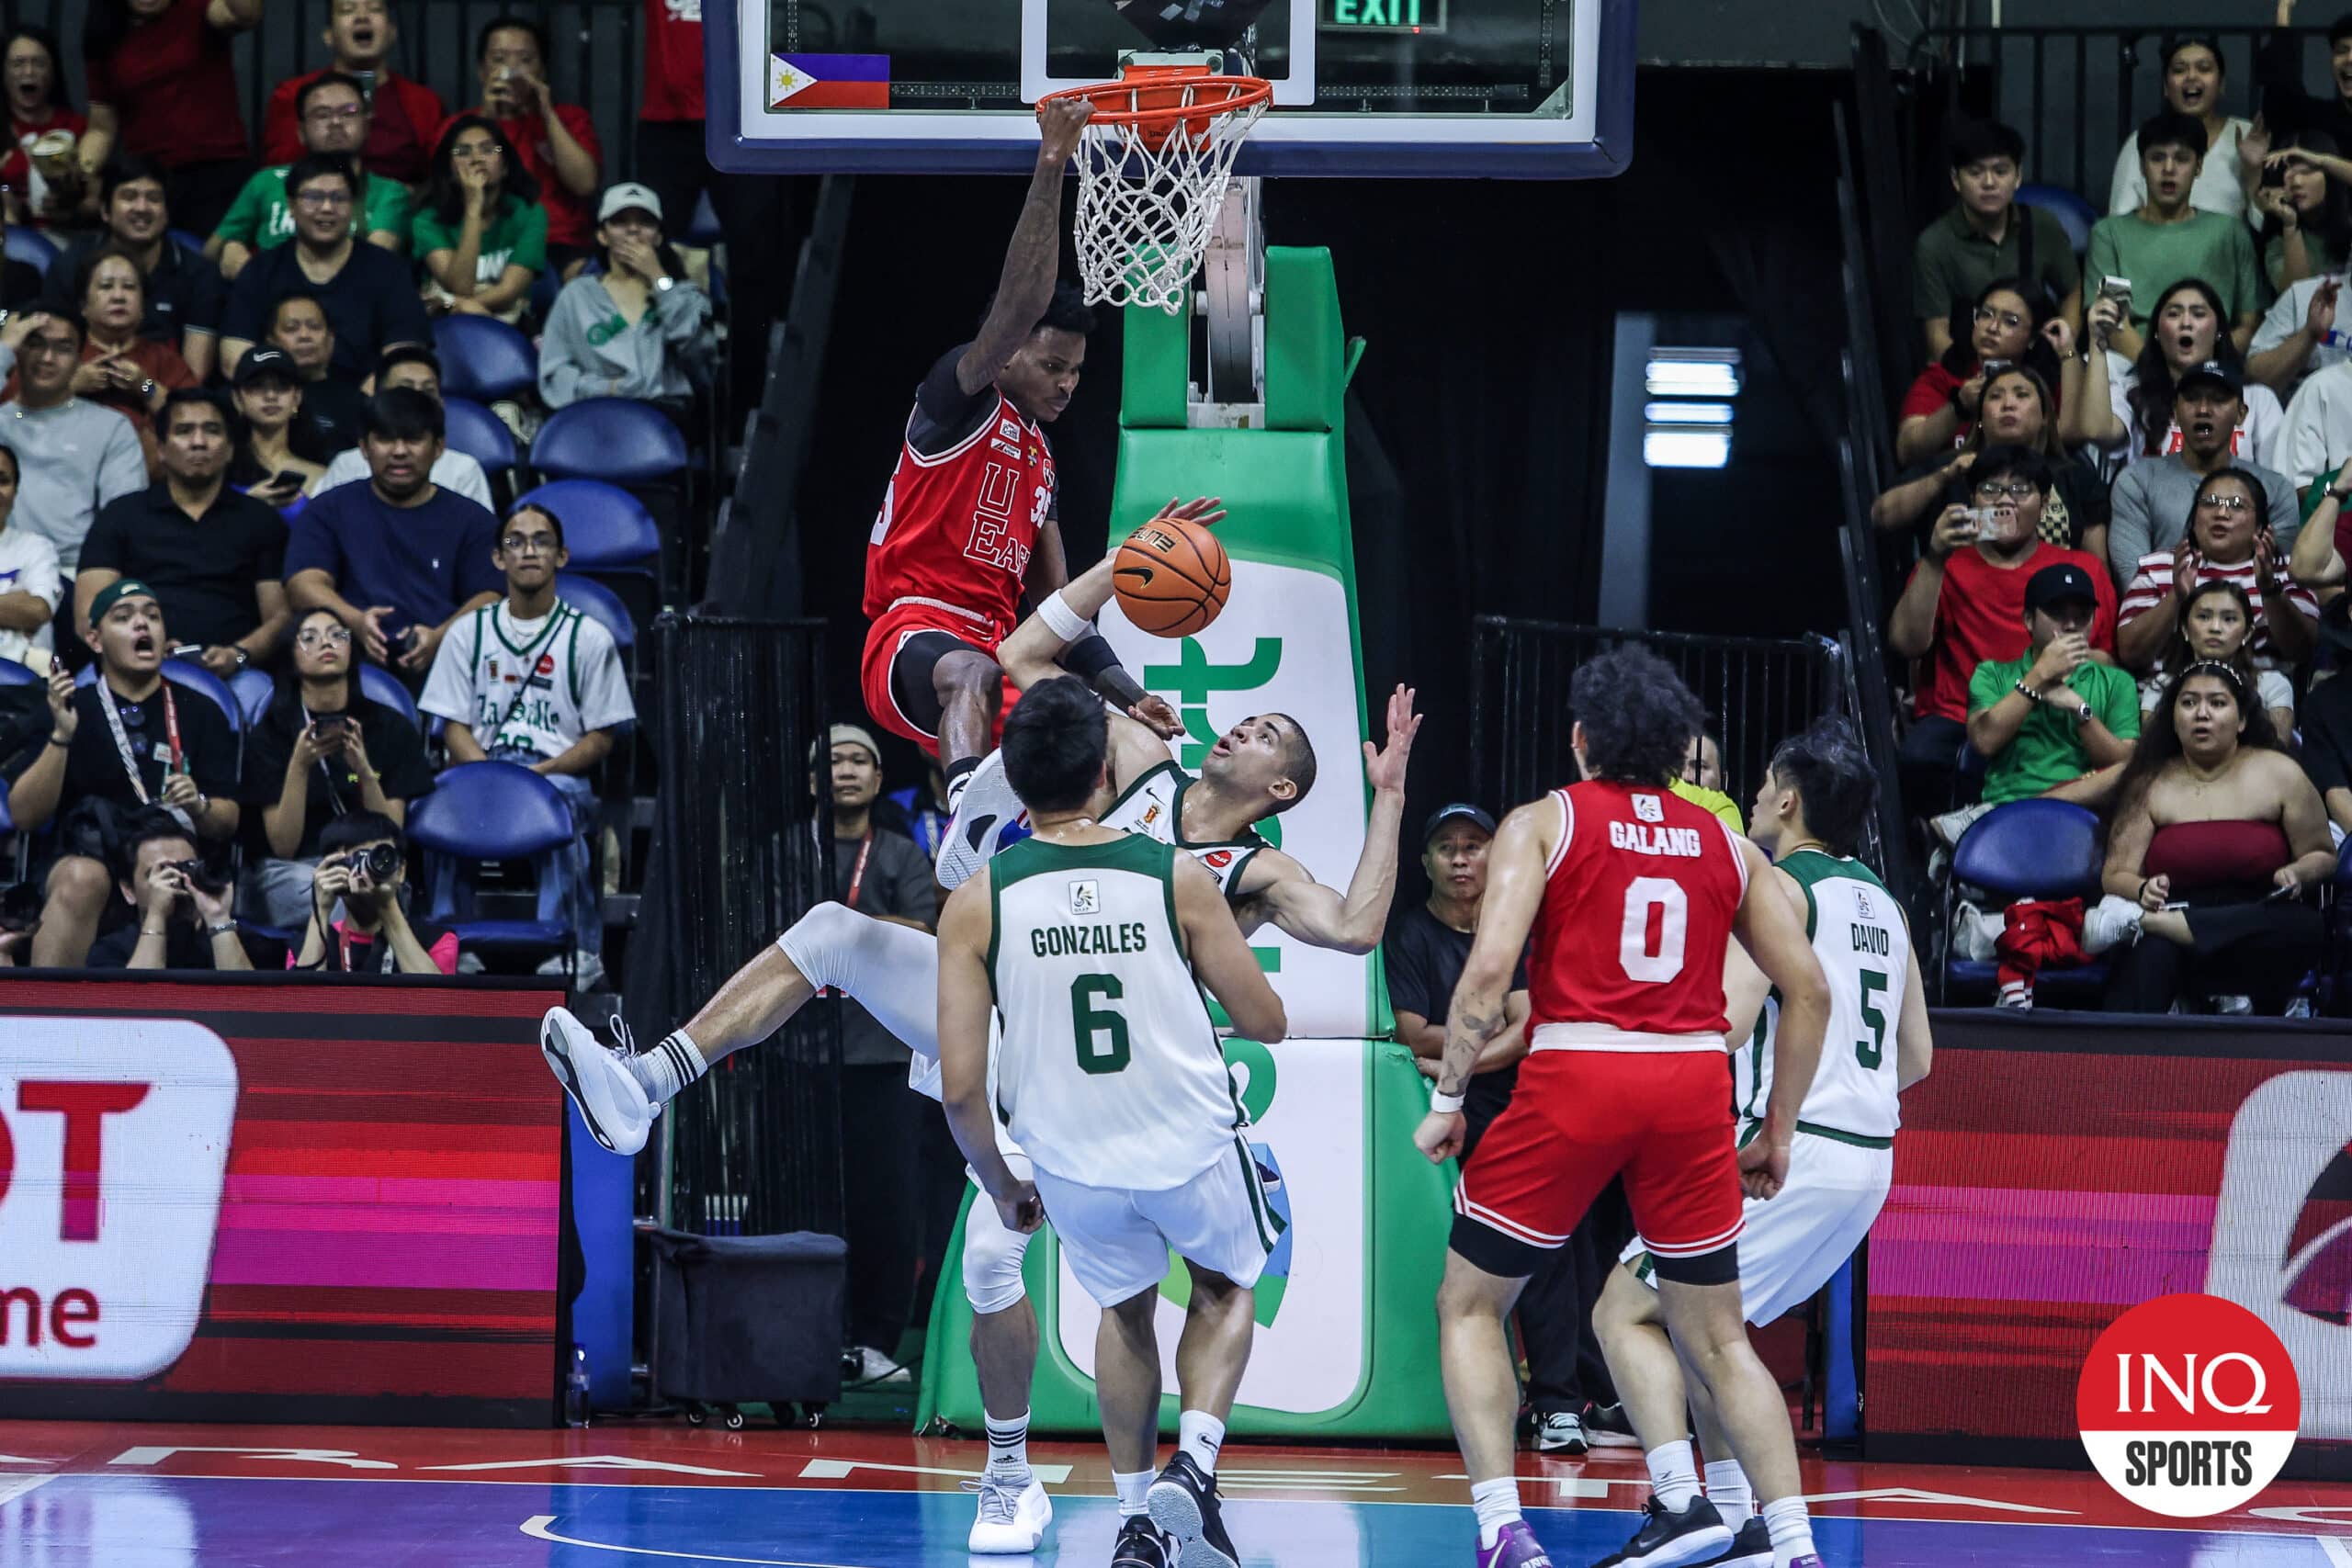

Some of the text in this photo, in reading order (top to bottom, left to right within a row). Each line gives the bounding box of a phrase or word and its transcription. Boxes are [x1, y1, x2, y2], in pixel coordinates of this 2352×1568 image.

[978, 462, 1020, 516] U
[1030, 486, 1052, 530] 35
[1128, 526, 1177, 554] ELITE
[1608, 820, 1702, 858] GALANG
[1031, 922, 1148, 958] GONZALES
[1620, 876, 1688, 984] 0
[1850, 922, 1890, 958] DAVID
[1070, 973, 1132, 1075] 6
[1855, 969, 1888, 1070] 5
[0, 1080, 153, 1241] T
